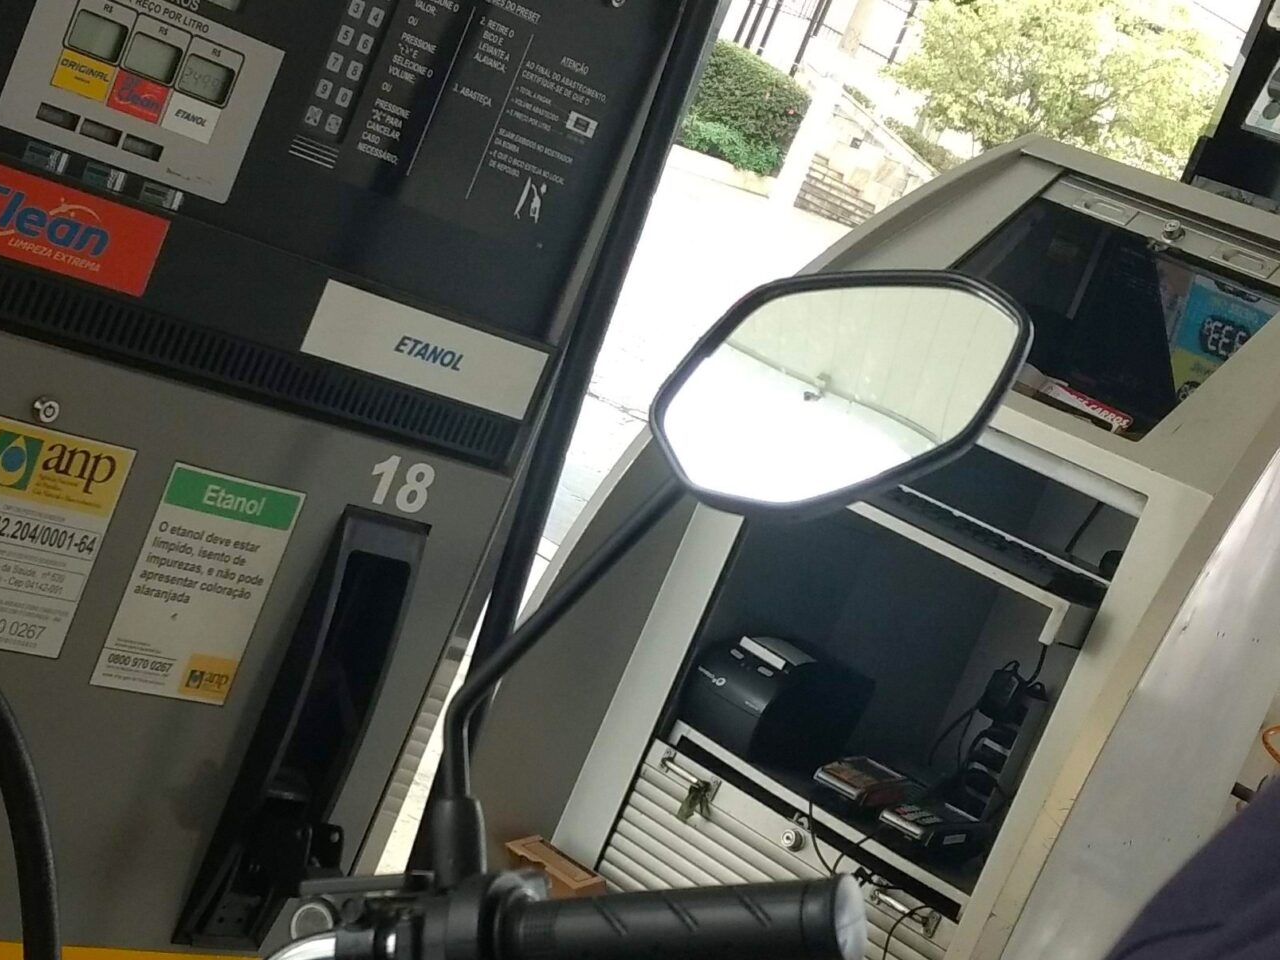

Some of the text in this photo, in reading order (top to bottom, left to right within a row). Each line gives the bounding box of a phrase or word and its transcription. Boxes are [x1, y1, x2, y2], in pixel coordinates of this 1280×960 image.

[103, 3, 114, 14] R$
[131, 0, 210, 33] REÇO POR LITRO
[516, 5, 541, 23] PRESET
[407, 15, 419, 26] OU
[487, 19, 509, 36] RETIRE
[159, 26, 169, 36] R$
[483, 30, 498, 44] BICO
[211, 48, 222, 58] R$
[401, 32, 437, 54] PRESSIONE
[478, 42, 504, 60] LEVANTE
[60, 58, 109, 83] ORIGINAL
[392, 54, 428, 76] SELECIONE
[525, 60, 536, 70] AO
[561, 56, 590, 76] ATENÇÃO
[381, 81, 393, 93] OU
[460, 86, 492, 107] ABASTEÇA
[175, 108, 207, 127] ETANOL
[374, 98, 411, 120] PRESSIONE
[385, 115, 403, 129] PARA
[361, 131, 381, 145] CASO
[8, 236, 101, 272] LIMPEZA EXTREMA
[393, 335, 465, 373] ETANOL
[41, 443, 117, 494] anp
[370, 454, 436, 514] 18
[202, 484, 266, 517] Etanol
[158, 521, 261, 553] O etanol deve estar
[197, 547, 231, 564] isento
[232, 554, 247, 567] de
[145, 552, 265, 587] impurezas, e não pode
[133, 583, 191, 605] alaranjada
[139, 568, 252, 601] apresentar coloração
[9, 621, 47, 641] 0267
[107, 652, 131, 667] 0800
[131, 657, 151, 670] 970
[151, 661, 174, 674] 0267
[202, 671, 230, 690] anp
